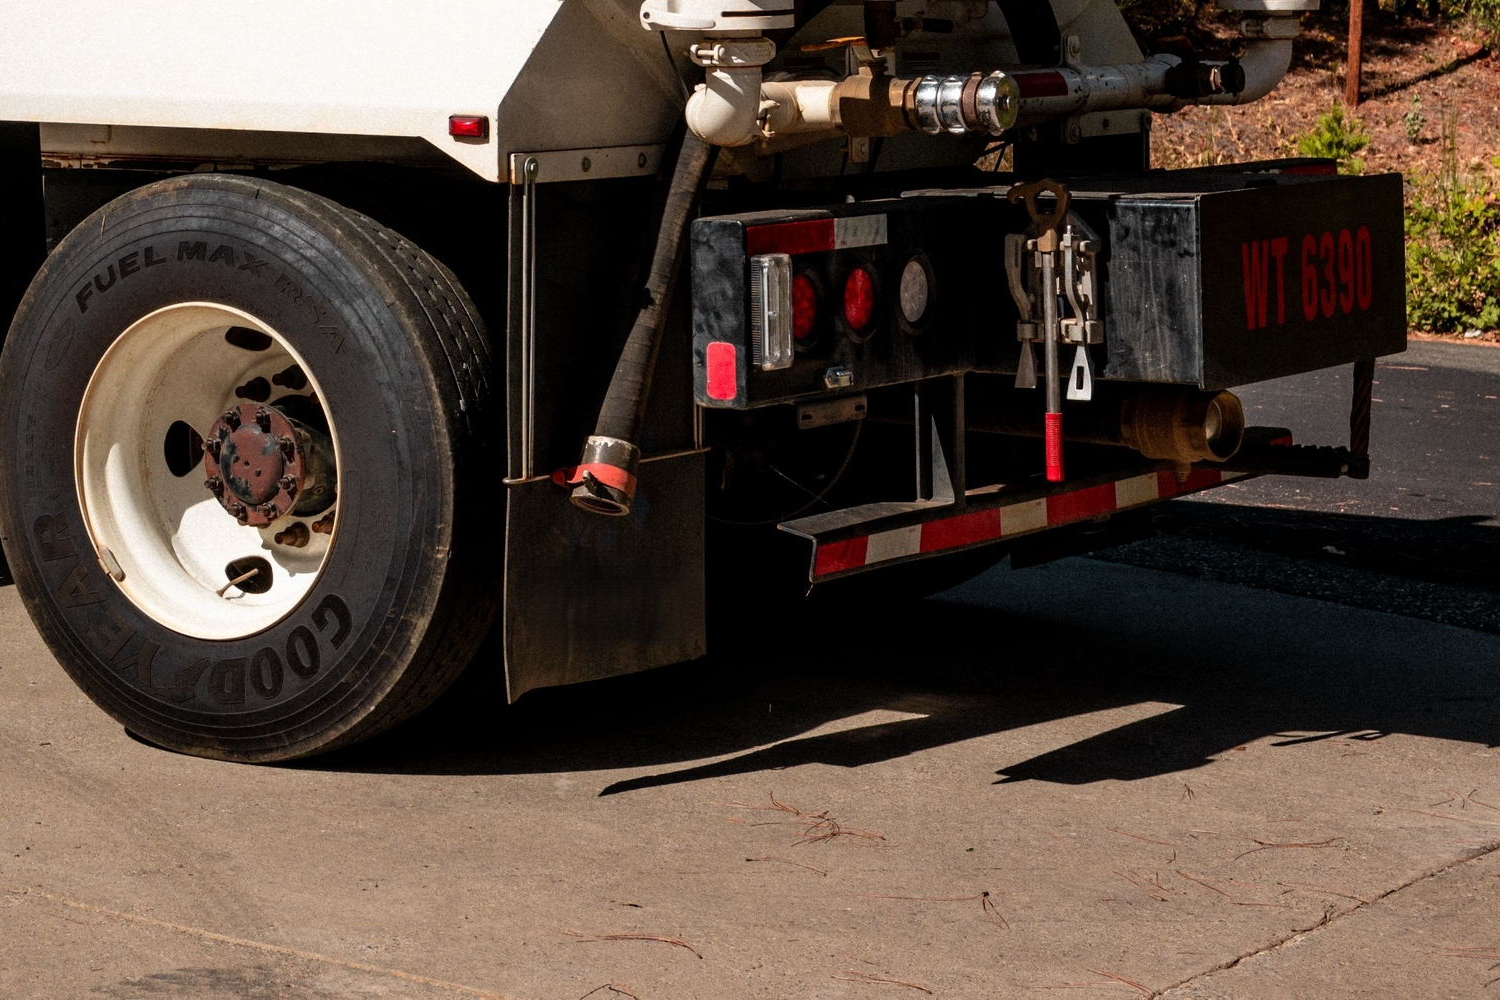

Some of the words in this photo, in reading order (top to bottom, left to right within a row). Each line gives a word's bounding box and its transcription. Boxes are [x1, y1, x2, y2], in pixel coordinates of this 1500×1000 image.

[75, 245, 167, 314] FUEL
[177, 240, 269, 278] MAX
[1241, 236, 1288, 330] WT
[1301, 225, 1372, 322] 6390
[33, 511, 353, 705] GOODYEAR
